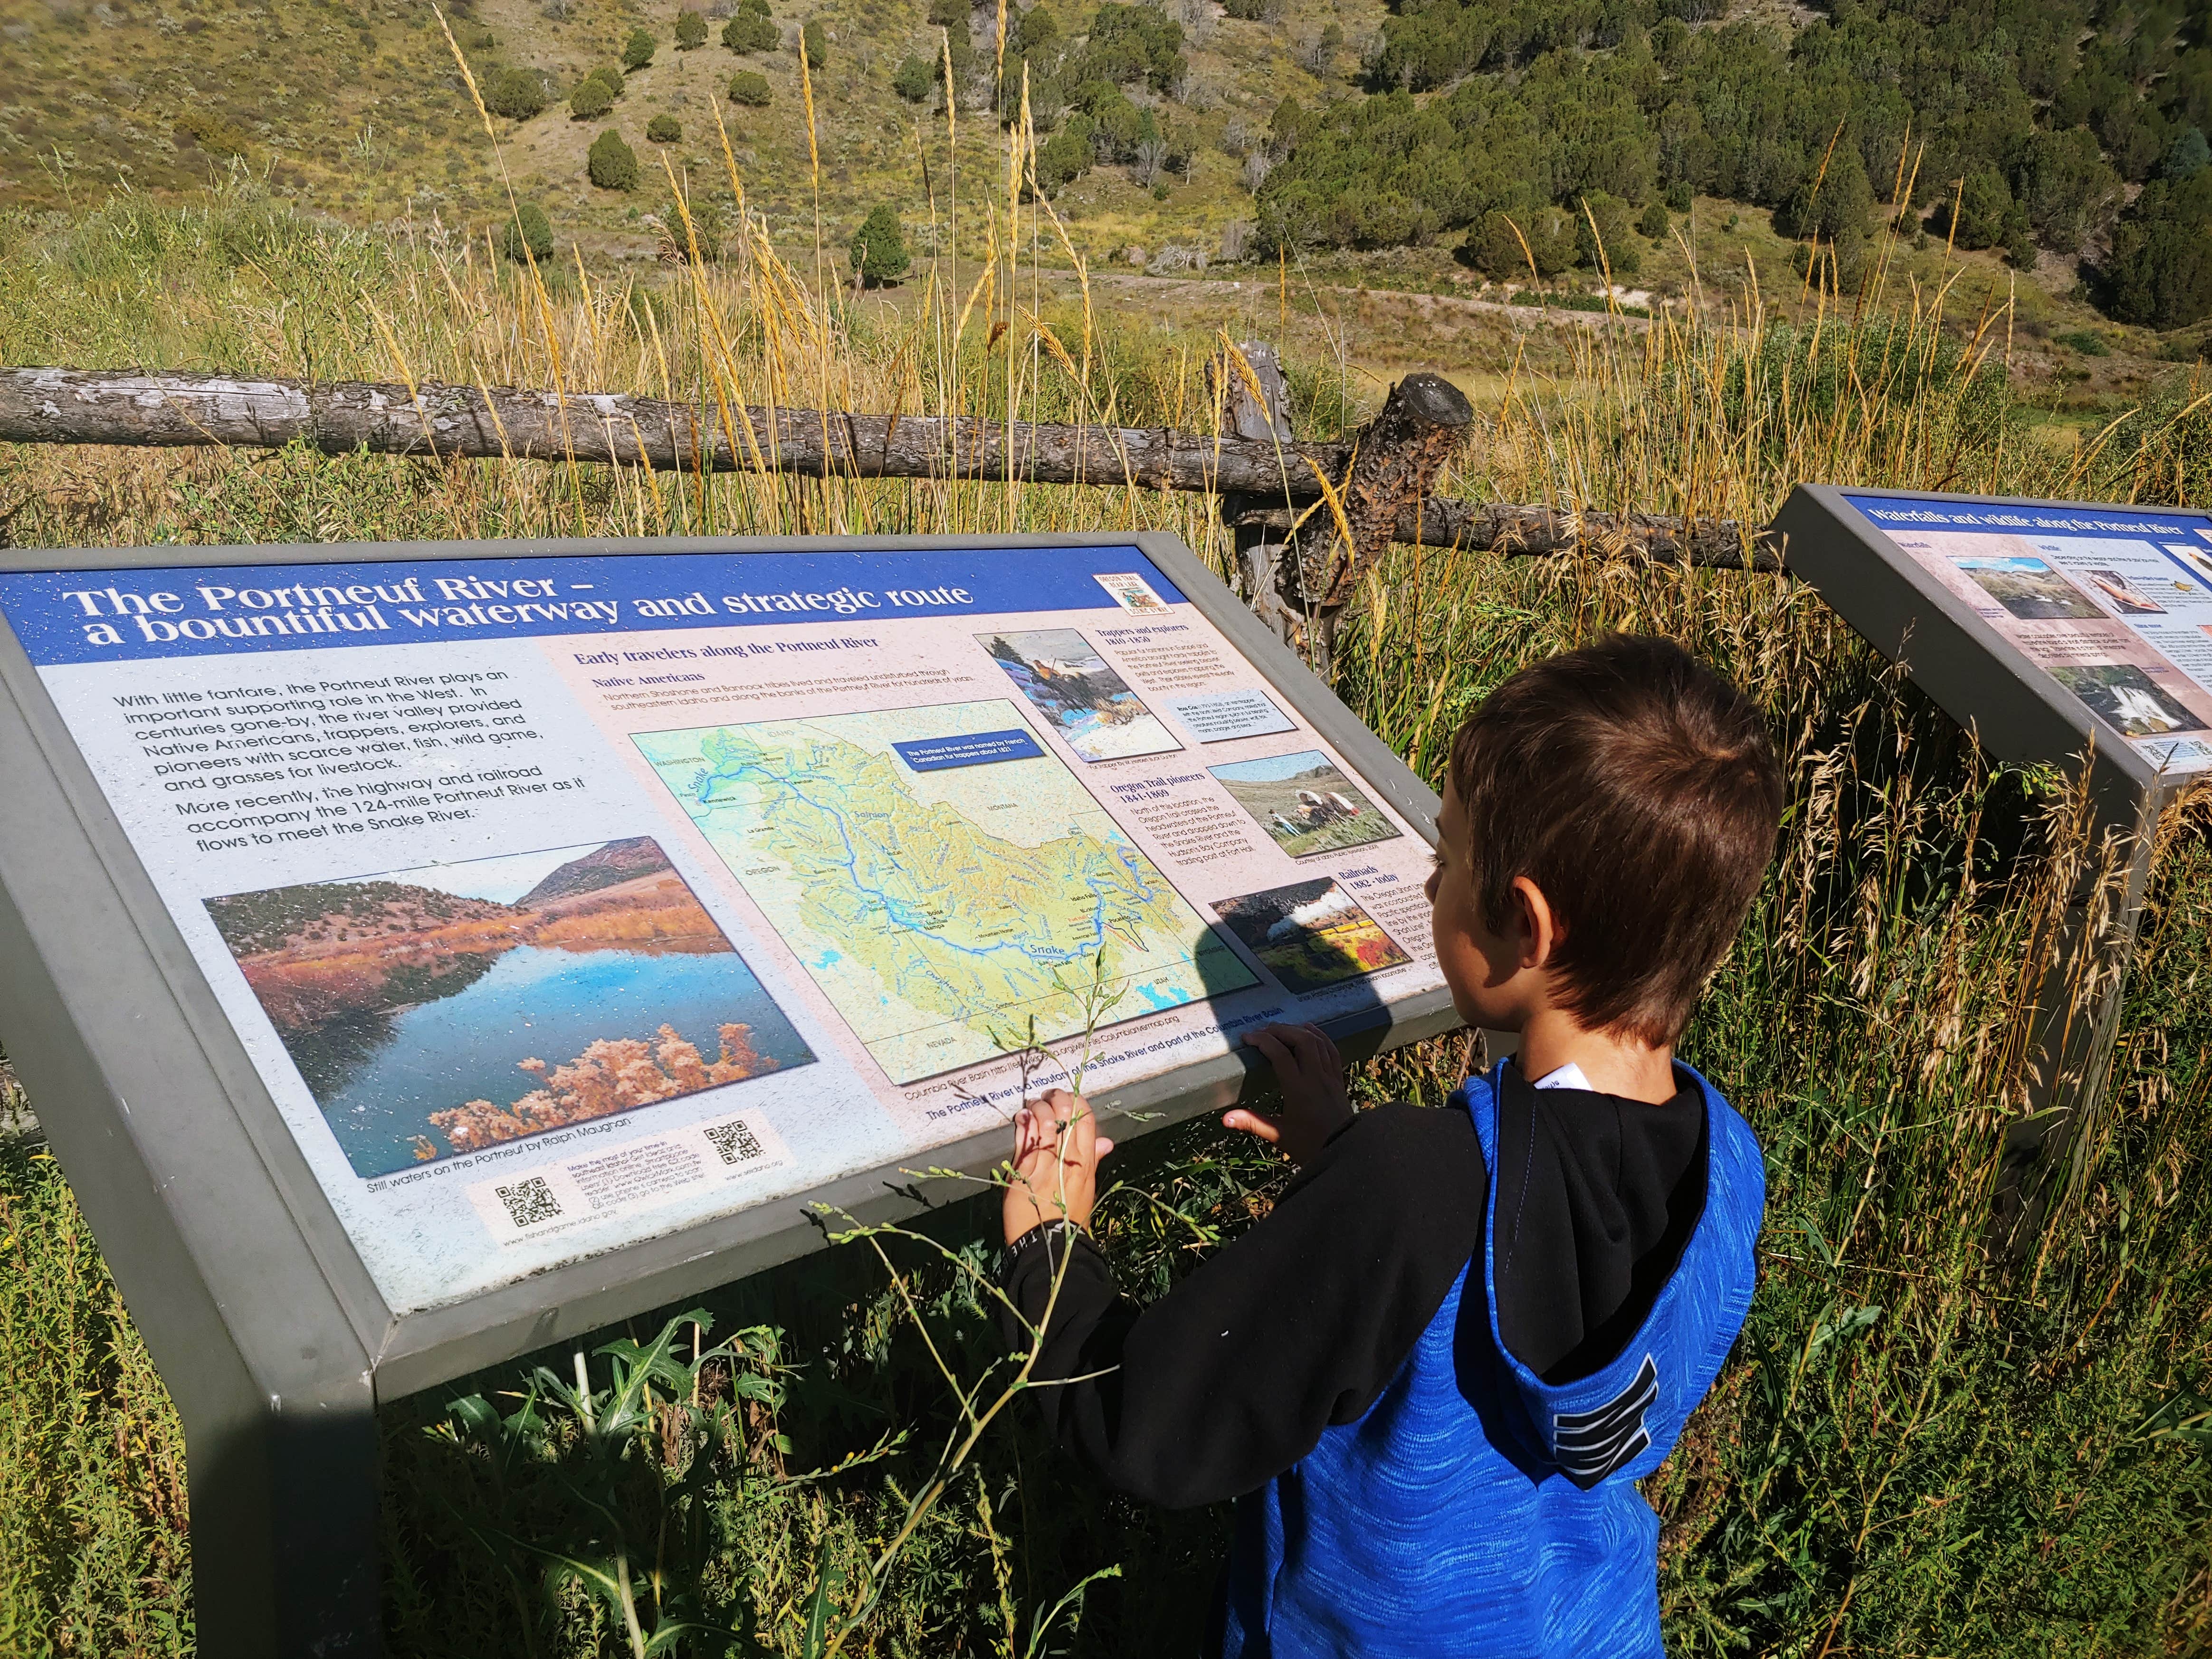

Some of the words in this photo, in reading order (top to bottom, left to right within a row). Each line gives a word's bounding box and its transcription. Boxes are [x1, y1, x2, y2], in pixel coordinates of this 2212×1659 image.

[1867, 509, 1950, 523] Waterfalls
[1948, 514, 1982, 524] and
[1978, 515, 2034, 526] wildlife
[2032, 517, 2077, 531] along
[2071, 519, 2097, 530] the
[2093, 521, 2152, 533] Portneuf
[2146, 524, 2184, 534] River
[63, 588, 184, 616] The
[195, 578, 427, 610] Portneuf
[433, 575, 558, 600] River
[83, 624, 125, 645] a
[133, 605, 391, 641] bountiful
[397, 601, 618, 627] waterway
[632, 592, 717, 617] and
[723, 587, 881, 613] strategic
[885, 586, 973, 606] route
[1152, 625, 1189, 633] explorers
[573, 651, 619, 665] Early
[623, 648, 697, 661] travelers
[700, 646, 748, 658] along
[747, 643, 774, 654] the
[775, 639, 841, 652] Portneuf
[840, 638, 878, 648] River
[592, 677, 634, 687] Native
[639, 674, 705, 684] Americans
[870, 671, 919, 680] undisturbed
[113, 695, 159, 707] With
[162, 692, 202, 703] little
[207, 687, 283, 700] fanfare,
[286, 684, 316, 694] the
[319, 677, 391, 691] Portneuf
[394, 676, 434, 686] River
[439, 673, 483, 685] plays
[124, 706, 221, 724] important
[226, 700, 325, 715] supporting
[329, 696, 363, 706] role
[366, 695, 384, 704] in
[386, 693, 415, 702] the
[416, 688, 463, 699] West.
[470, 687, 487, 696] In
[135, 725, 225, 740] centuries
[231, 716, 315, 734] gone-by,
[318, 714, 348, 724] the
[353, 711, 389, 721] river
[393, 706, 442, 717] valley
[448, 699, 522, 715] provided
[143, 743, 209, 756] Native
[216, 734, 320, 750] Americans,
[324, 726, 404, 740] trappers,
[409, 719, 489, 733] explorers,
[493, 714, 526, 725] and
[154, 758, 241, 776] pioneers
[245, 752, 284, 764] with
[288, 747, 352, 760] scarce
[356, 742, 410, 753] water,
[413, 737, 448, 748] fish,
[450, 733, 485, 744] wild
[489, 731, 543, 744] game,
[654, 757, 706, 767] WASHINGTON
[165, 777, 206, 791] and
[212, 771, 285, 789] grasses
[288, 767, 313, 778] for
[317, 758, 401, 775] livestock.
[688, 767, 708, 792] Snake
[1110, 783, 1148, 793] Oregon
[1144, 777, 1168, 787] Trail
[1166, 773, 1205, 786] pioneers
[176, 801, 229, 815] More
[235, 791, 318, 808] recently,
[322, 787, 353, 798] the
[356, 779, 431, 795] highway
[439, 772, 474, 785] and
[477, 766, 543, 782] railroad
[187, 810, 309, 833] accompany
[315, 806, 347, 818] the
[352, 796, 430, 813] 124-mile
[433, 786, 505, 803] Portneuf
[506, 784, 547, 795] River
[553, 782, 572, 790] as
[572, 778, 585, 788] it
[196, 838, 248, 851] flows
[251, 833, 272, 844] to
[277, 825, 328, 841] meet
[333, 823, 364, 834] the
[368, 815, 424, 830] Snake
[427, 810, 475, 822] River.
[745, 866, 781, 876] OREGON
[1338, 866, 1378, 879] Railroads
[1350, 879, 1372, 889] 1882
[1375, 874, 1399, 884] today
[926, 908, 944, 916] Boise
[1030, 944, 1066, 955] Snake
[926, 1036, 957, 1049] NEVADA
[925, 1110, 946, 1120] The
[988, 1088, 1014, 1100] River
[1096, 1055, 1125, 1067] Snake
[1124, 1048, 1145, 1058] River
[1148, 1041, 1165, 1052] and
[1165, 1036, 1183, 1049] part
[1183, 1033, 1192, 1041] of
[367, 1181, 387, 1193] Still
[390, 1171, 431, 1186] waters
[434, 1166, 450, 1175] on
[453, 1160, 473, 1170] the
[475, 1144, 523, 1164] Portneuf
[525, 1142, 541, 1151] by
[542, 1133, 576, 1146] Ralph
[576, 1118, 631, 1137] Maughan
